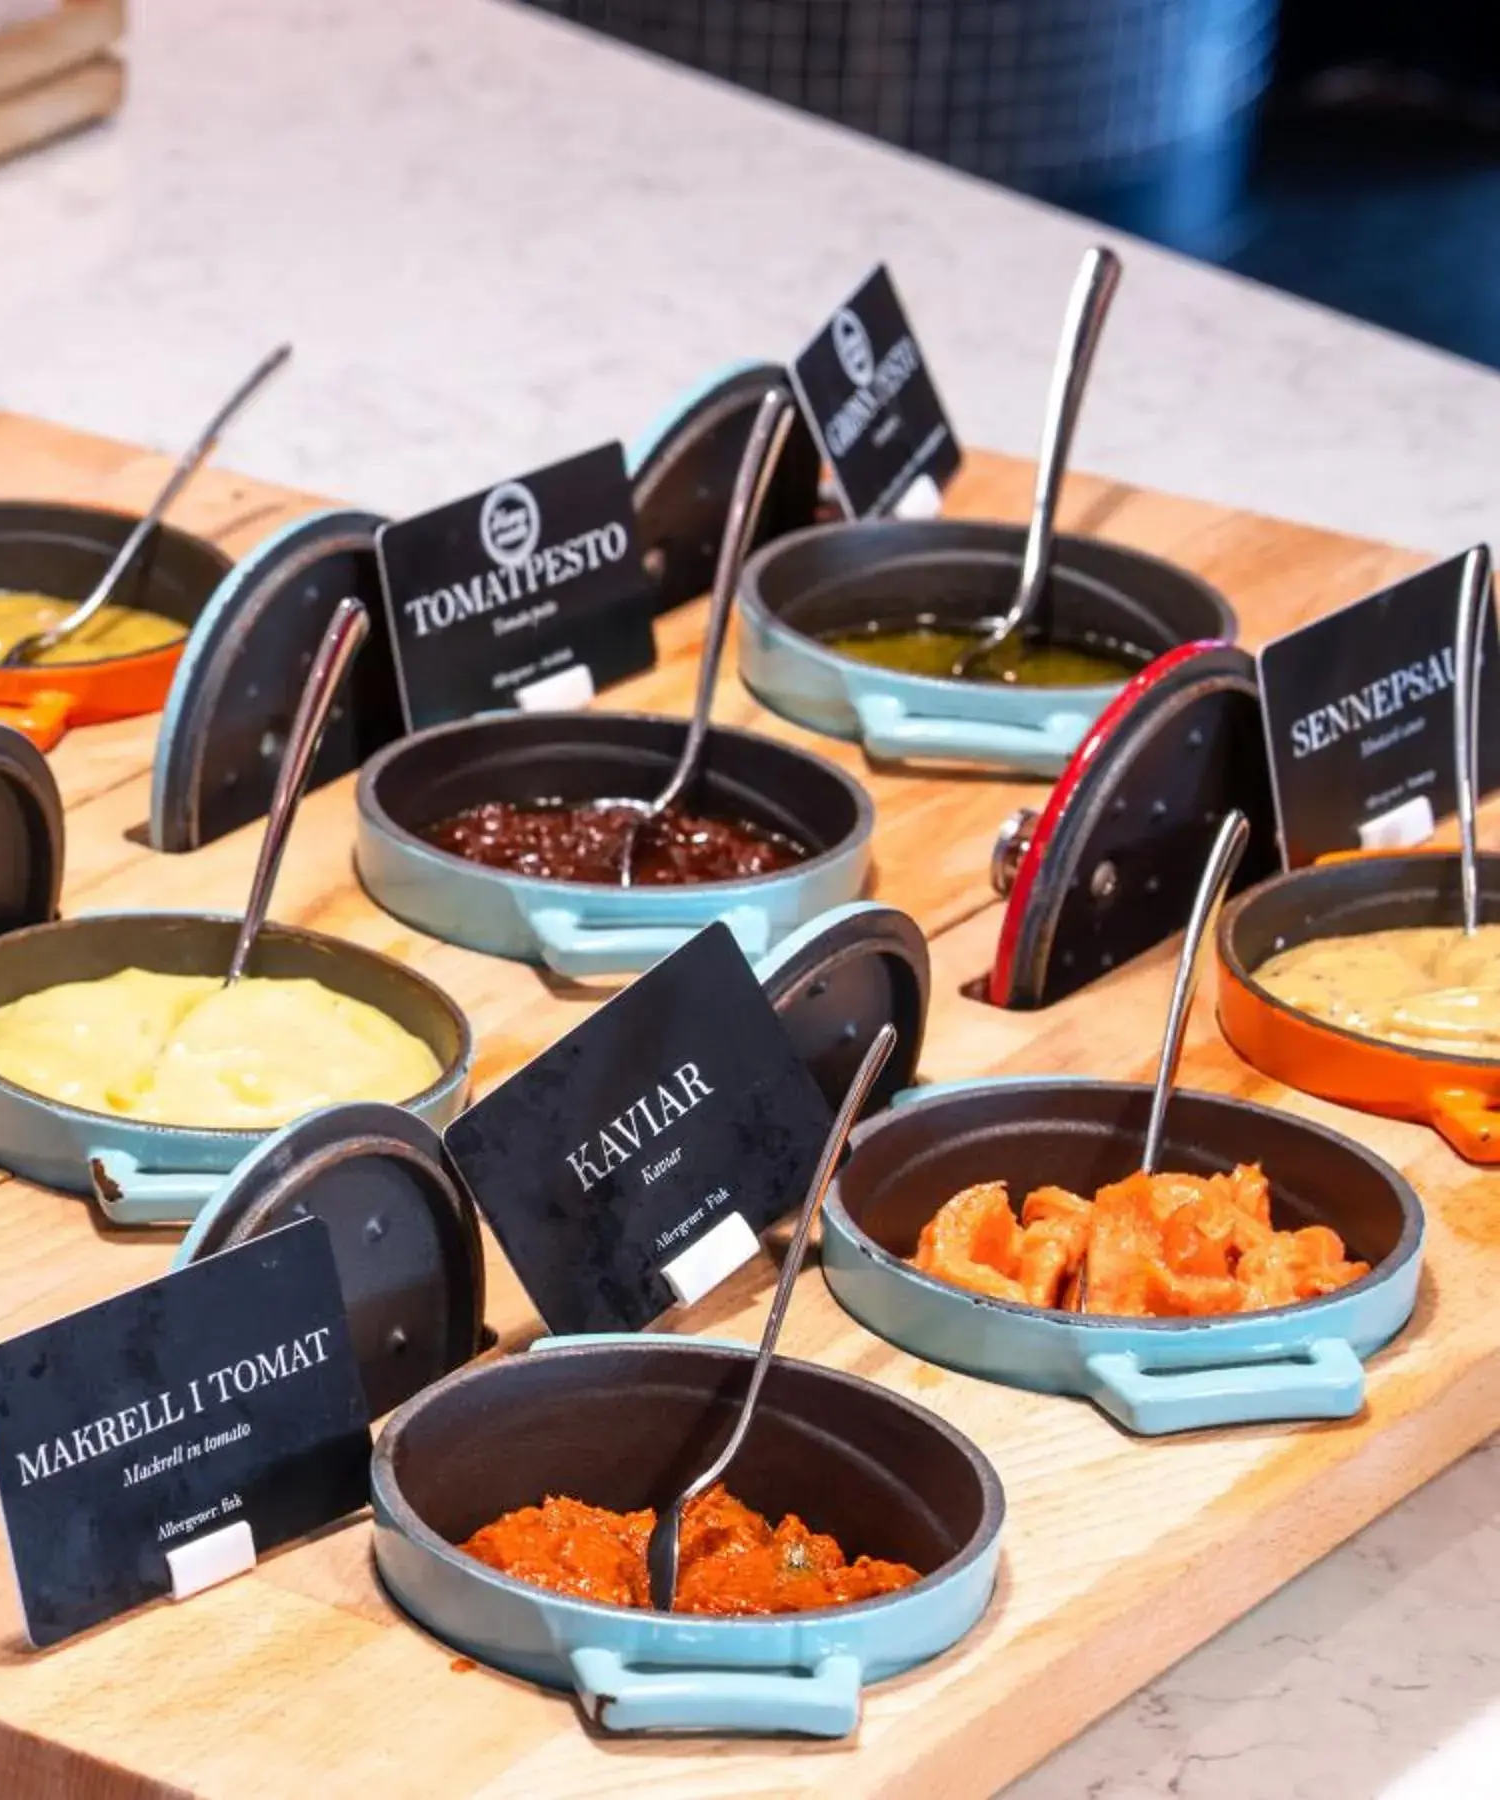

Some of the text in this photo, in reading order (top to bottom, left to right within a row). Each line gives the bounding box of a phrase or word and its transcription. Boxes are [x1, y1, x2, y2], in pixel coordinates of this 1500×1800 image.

[405, 521, 628, 637] TOMATPESTO
[1290, 646, 1458, 759] SENNEPSAU
[566, 1061, 715, 1192] KAVIAR
[15, 1327, 330, 1487] MAKRELL I TOMAT
[123, 1422, 251, 1488] Mackrell in tomato
